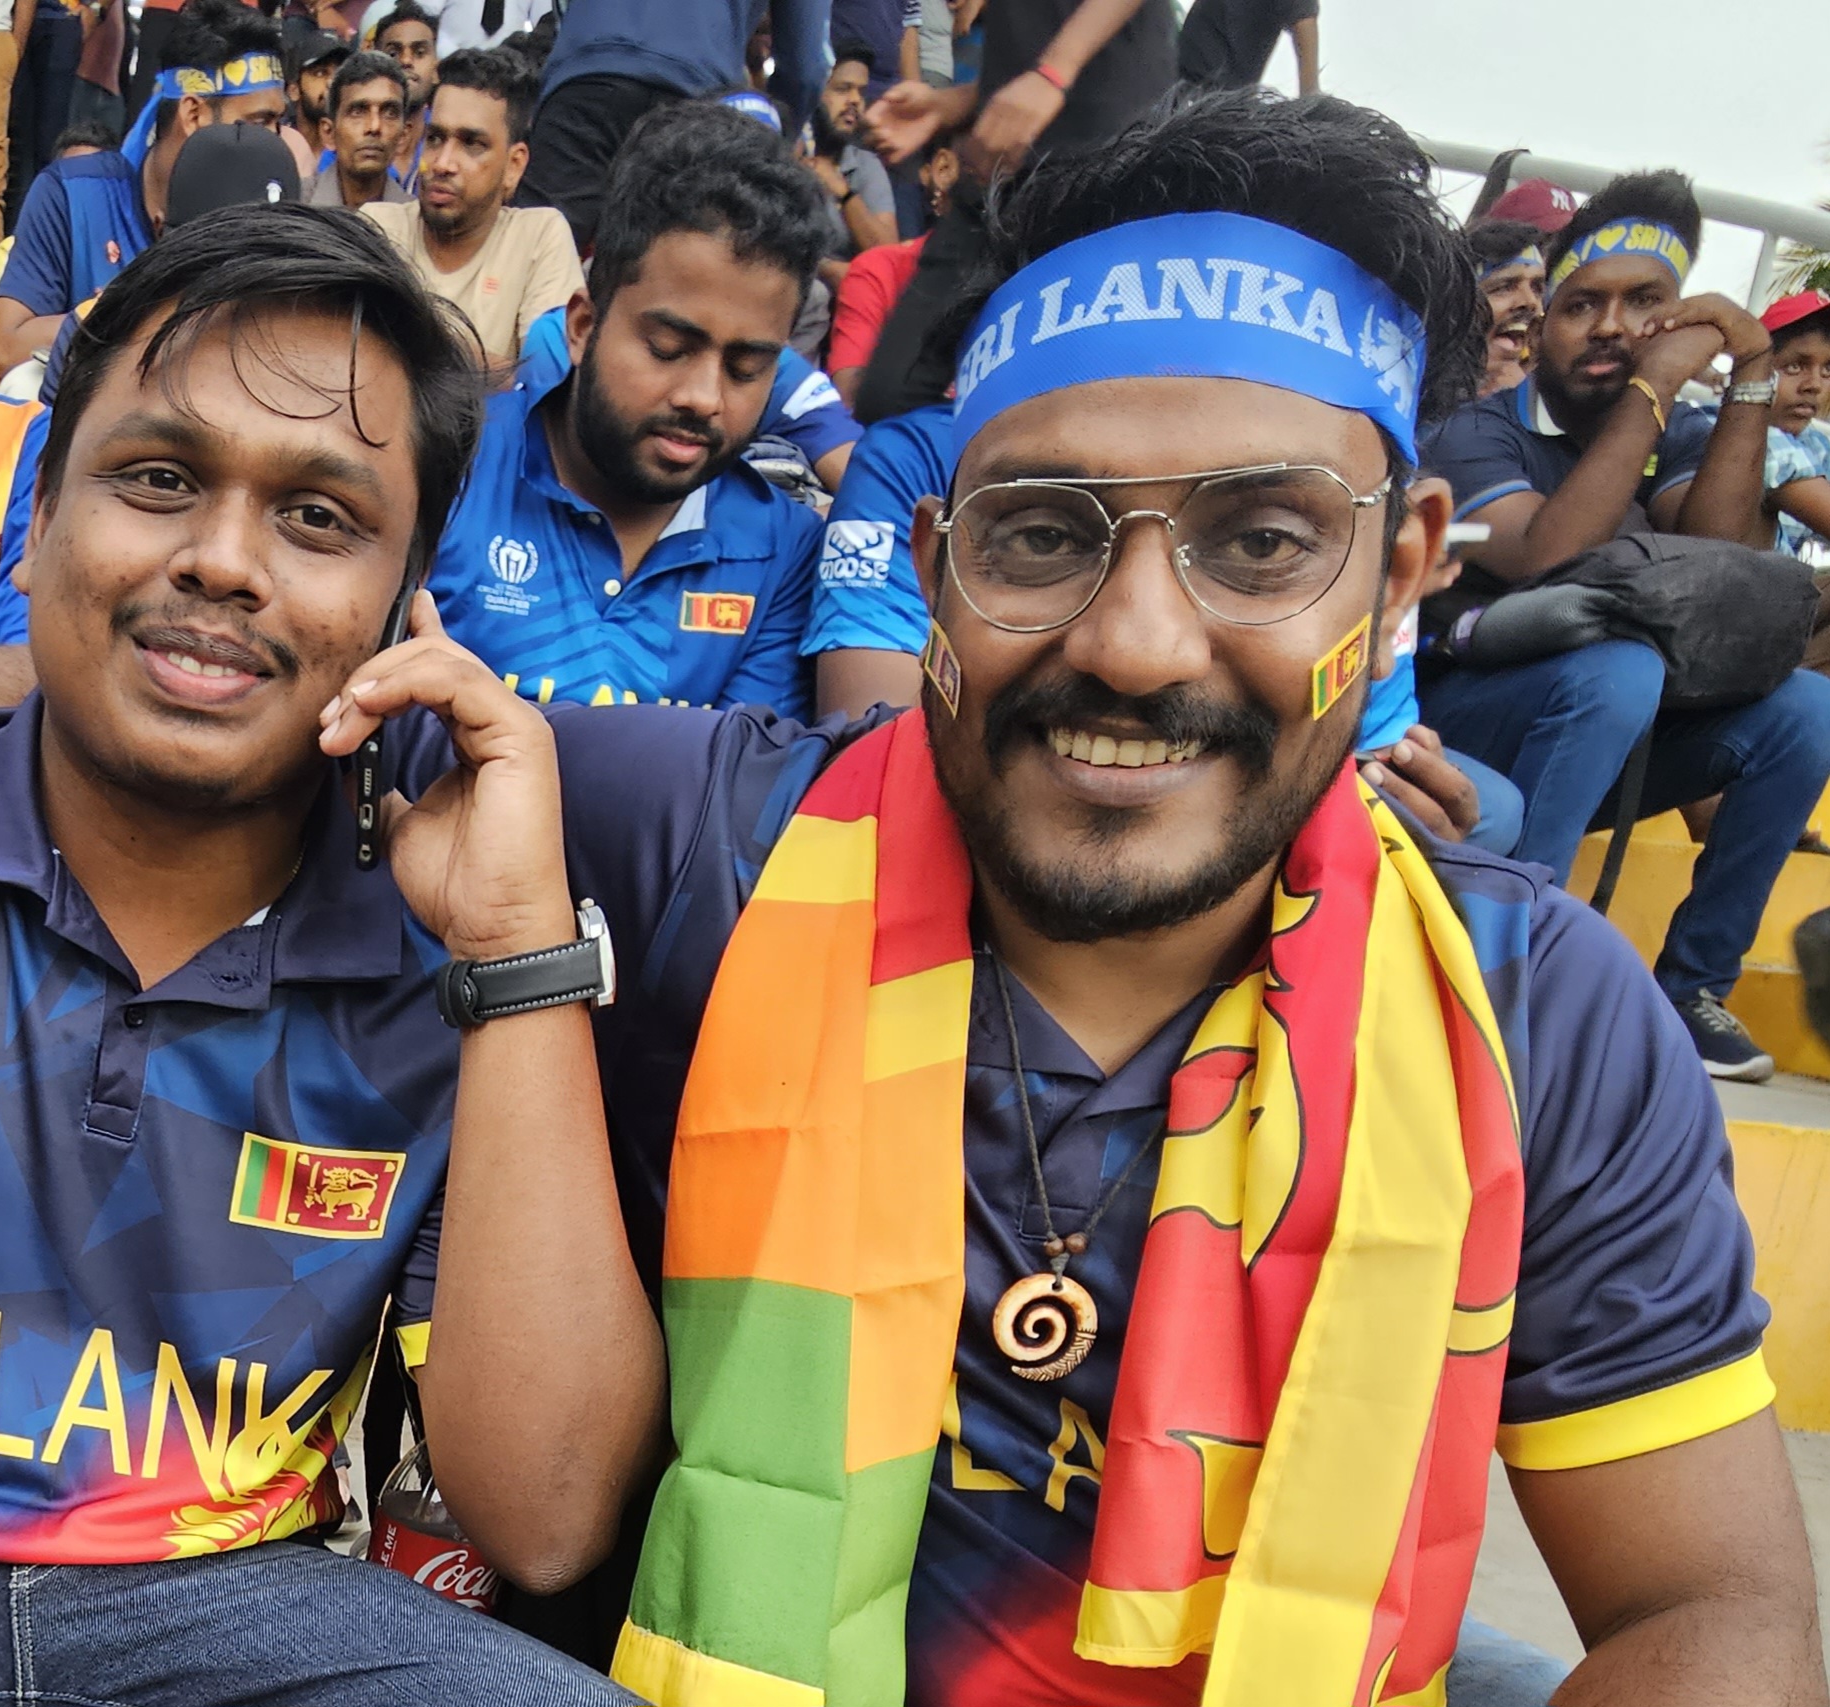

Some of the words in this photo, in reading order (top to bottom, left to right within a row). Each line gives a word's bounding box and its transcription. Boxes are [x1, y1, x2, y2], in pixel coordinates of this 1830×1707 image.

[1624, 223, 1662, 251] SRI
[954, 301, 1023, 420] SRI
[1030, 257, 1353, 357] LANKA
